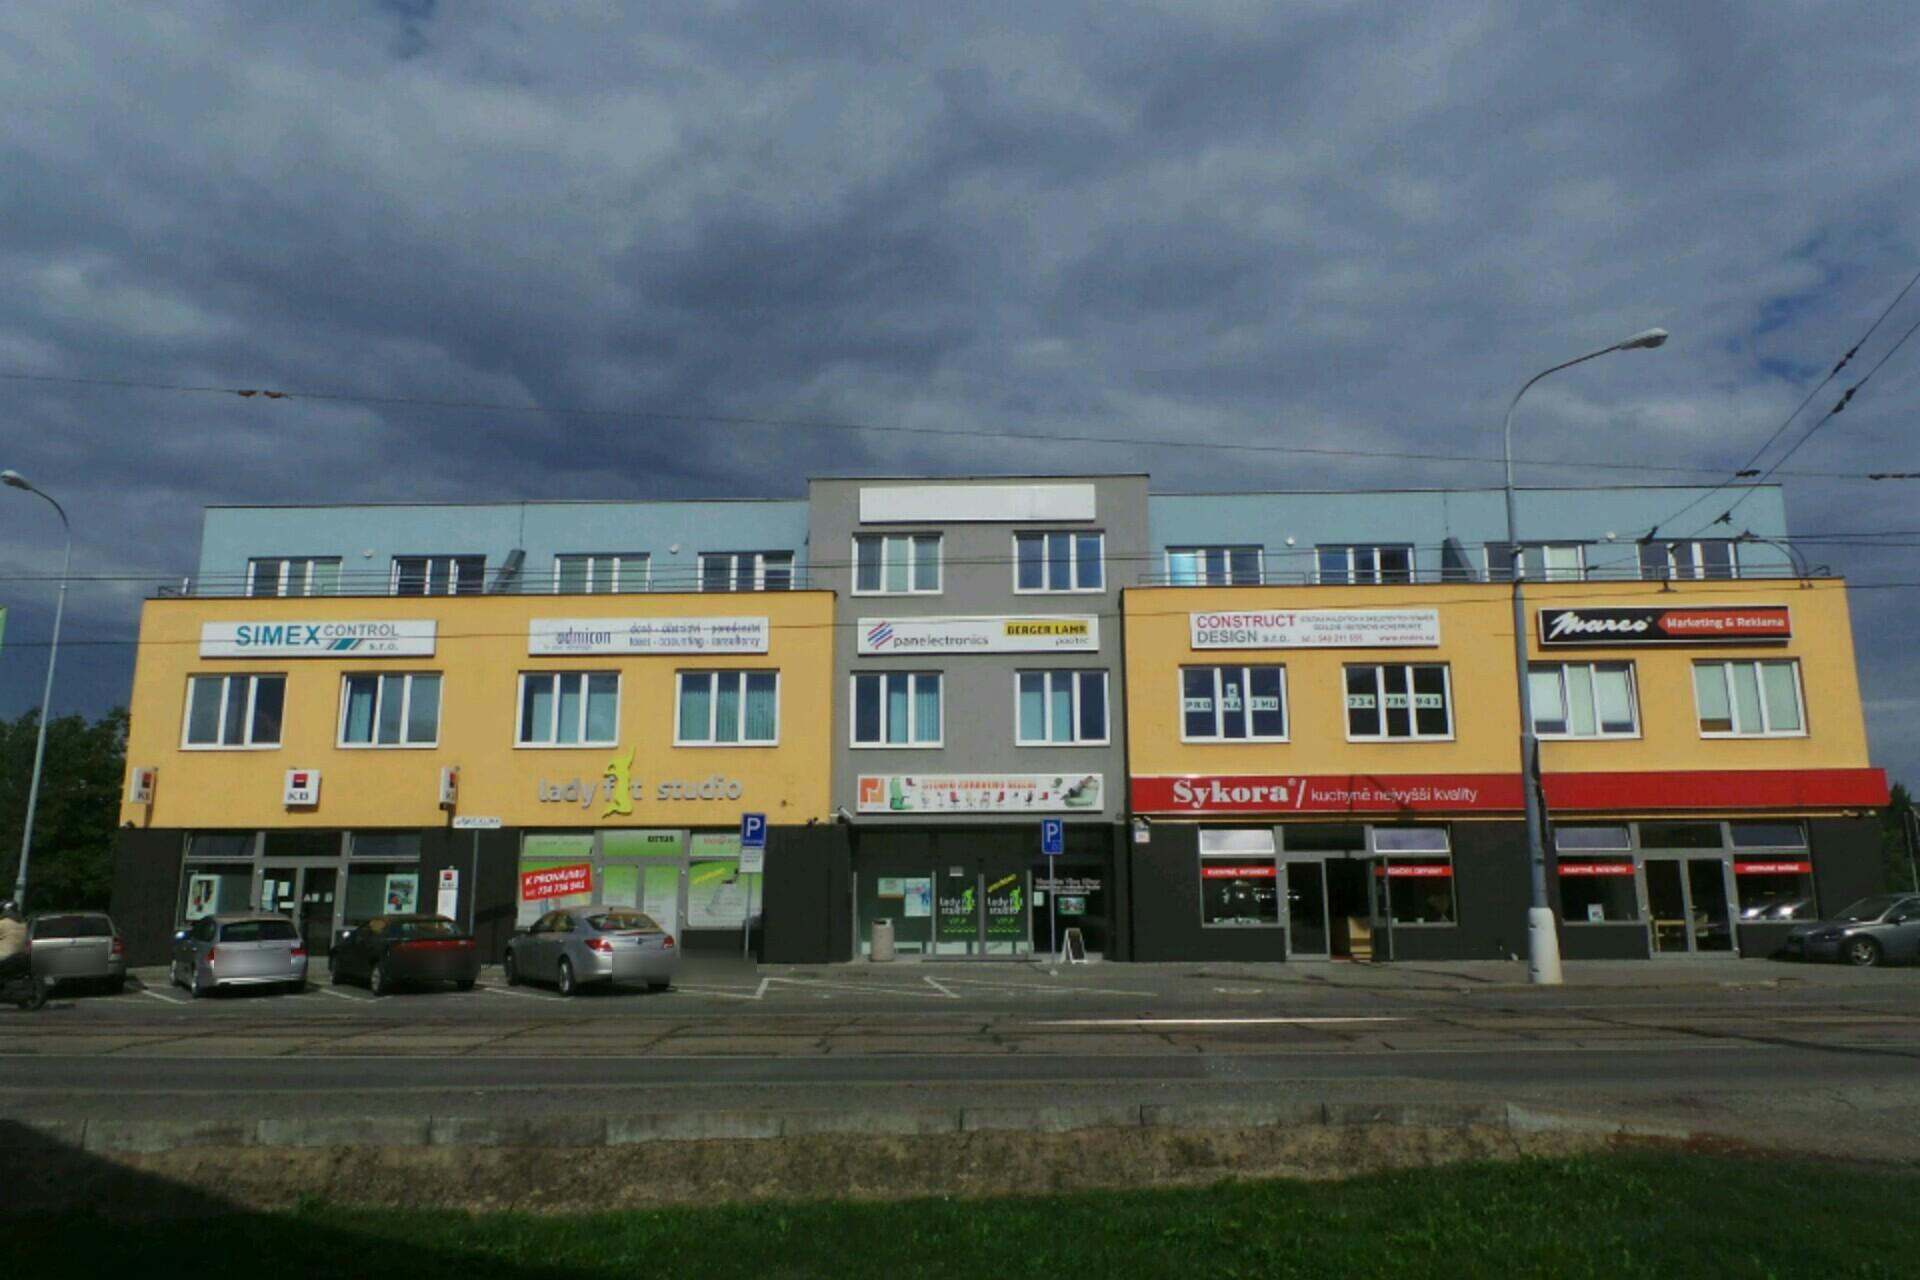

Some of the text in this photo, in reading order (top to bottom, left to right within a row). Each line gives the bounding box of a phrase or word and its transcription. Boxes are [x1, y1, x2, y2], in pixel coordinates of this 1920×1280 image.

[1196, 614, 1296, 629] CONSTRUCT
[1667, 616, 1785, 630] Marketing & Reklama
[235, 623, 399, 647] SIMEX CONTROL
[1007, 624, 1051, 636] BERGER
[1197, 629, 1258, 644] DESIGN
[893, 634, 990, 648] panelectronics
[287, 791, 309, 801] KB
[538, 777, 597, 810] lady
[656, 774, 743, 801] studio
[1173, 779, 1289, 809] Sykora
[1311, 786, 1371, 804] kuchyně
[1434, 785, 1478, 803] kvality
[746, 817, 761, 837] P
[1046, 822, 1059, 843] P
